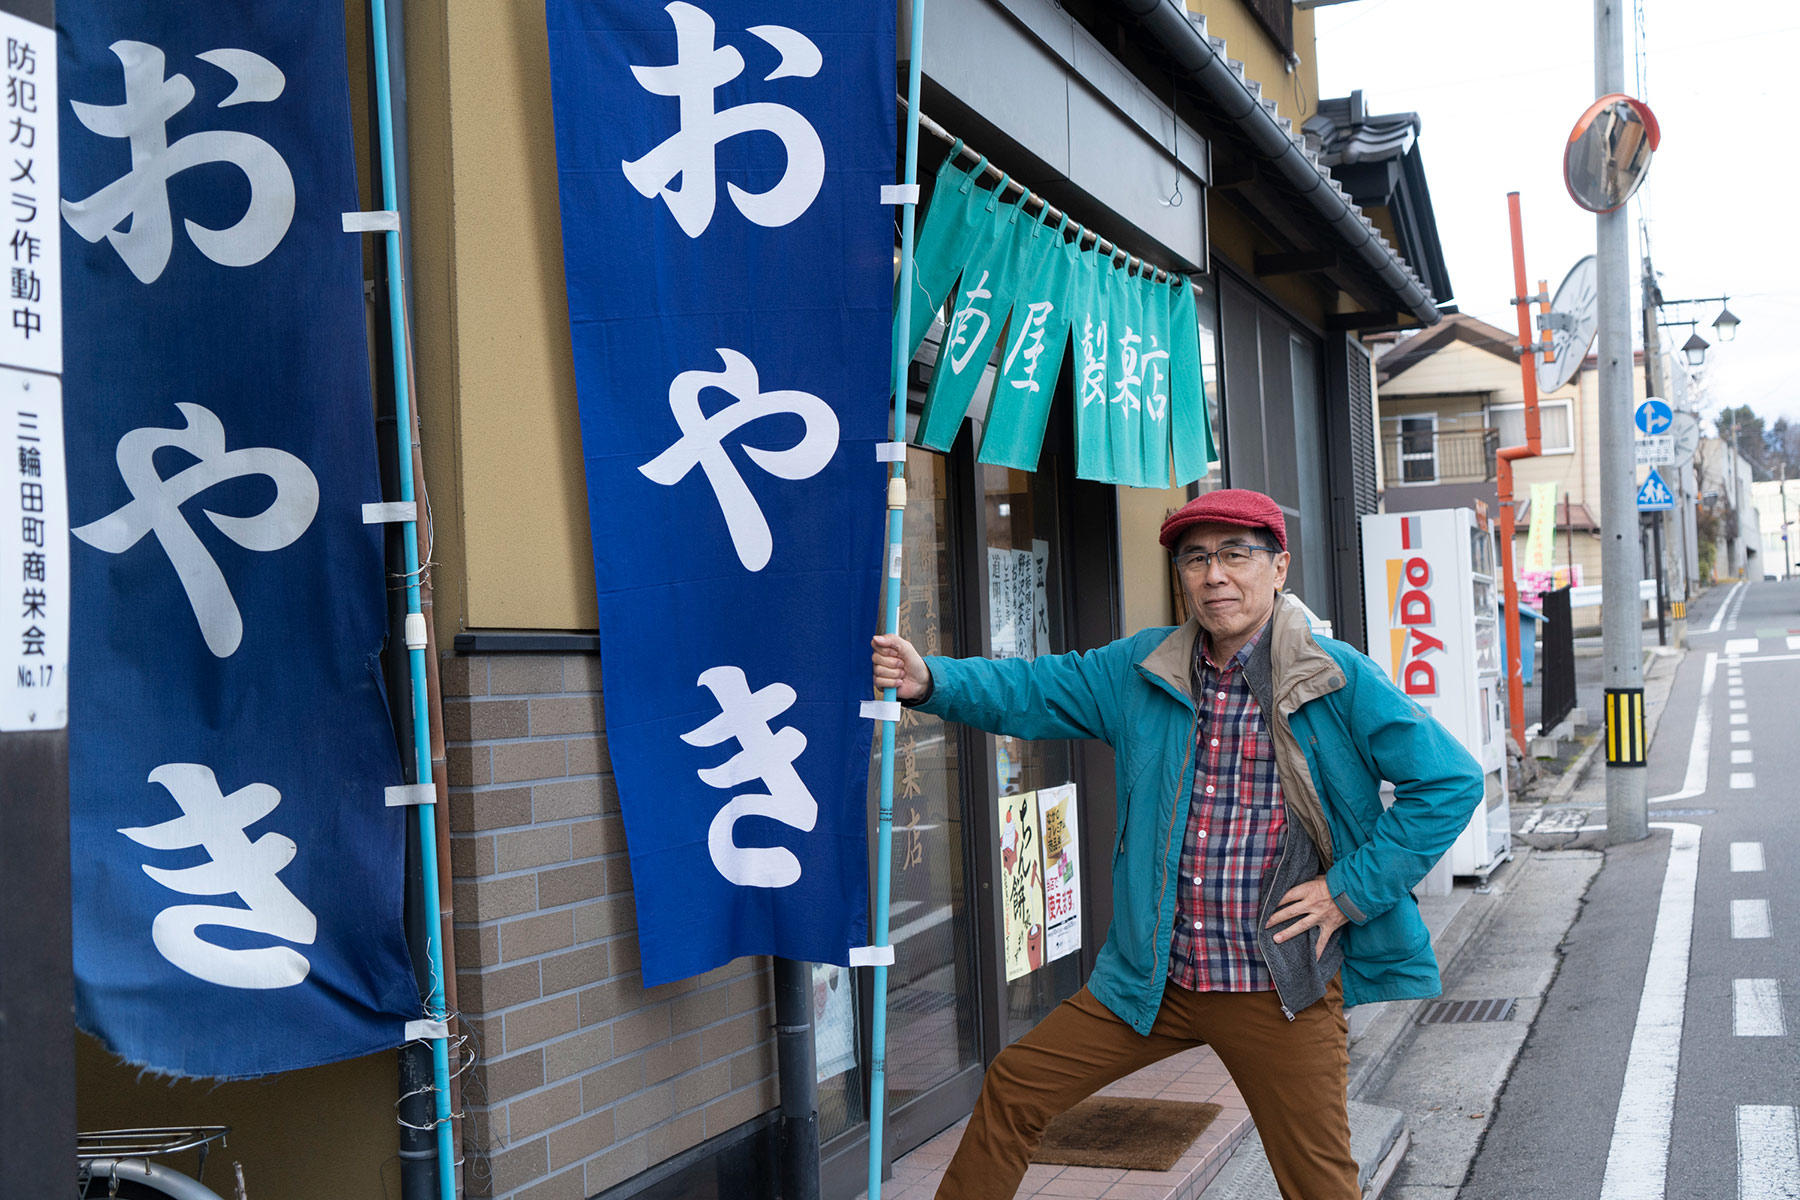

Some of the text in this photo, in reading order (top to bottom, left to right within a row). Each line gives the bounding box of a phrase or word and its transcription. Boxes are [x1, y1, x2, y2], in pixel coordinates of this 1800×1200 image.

[7, 37, 41, 340] 防犯カメラ作動中
[622, 1, 840, 887] おやき
[17, 411, 46, 657] 三輪田町商栄会
[61, 40, 320, 989] おやき
